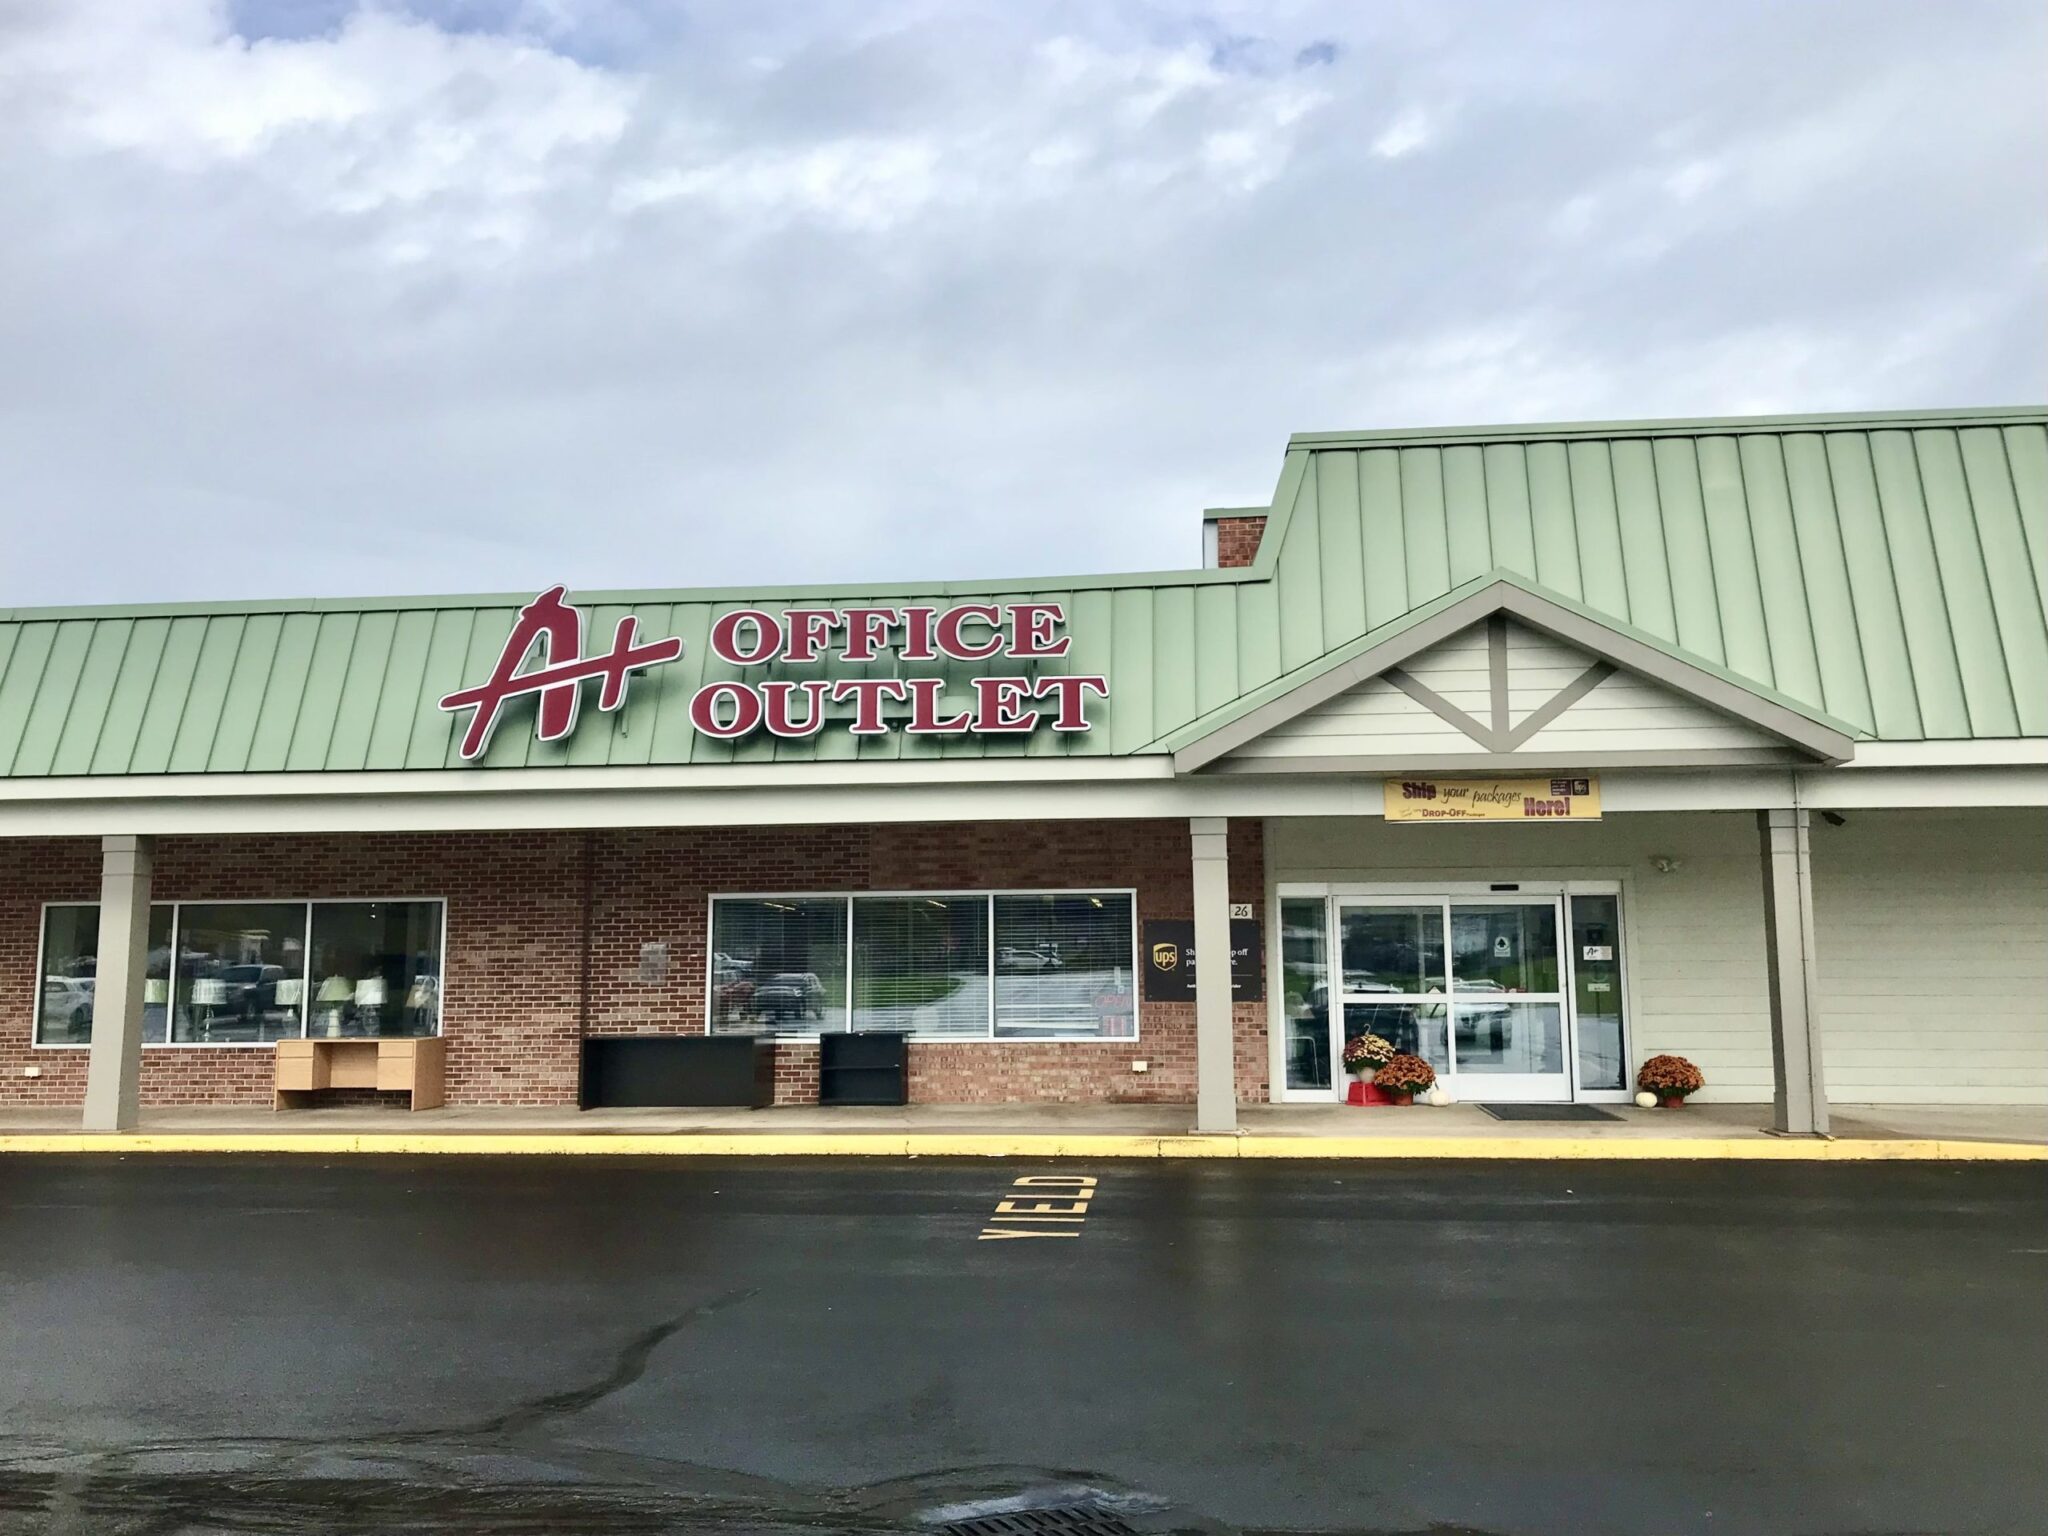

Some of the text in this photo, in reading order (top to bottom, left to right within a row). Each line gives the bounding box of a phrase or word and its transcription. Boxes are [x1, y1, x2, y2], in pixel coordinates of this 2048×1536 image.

[711, 603, 1073, 666] OFFICE
[438, 584, 684, 760] A+
[689, 675, 1109, 739] OUTLET
[1402, 782, 1522, 808] Ship your packages
[1524, 797, 1570, 816] Here!
[1234, 905, 1248, 917] 26
[1155, 951, 1176, 967] ups
[1185, 948, 1196, 956] Sh
[1237, 948, 1249, 956] off
[977, 1175, 1098, 1240] YIELD
